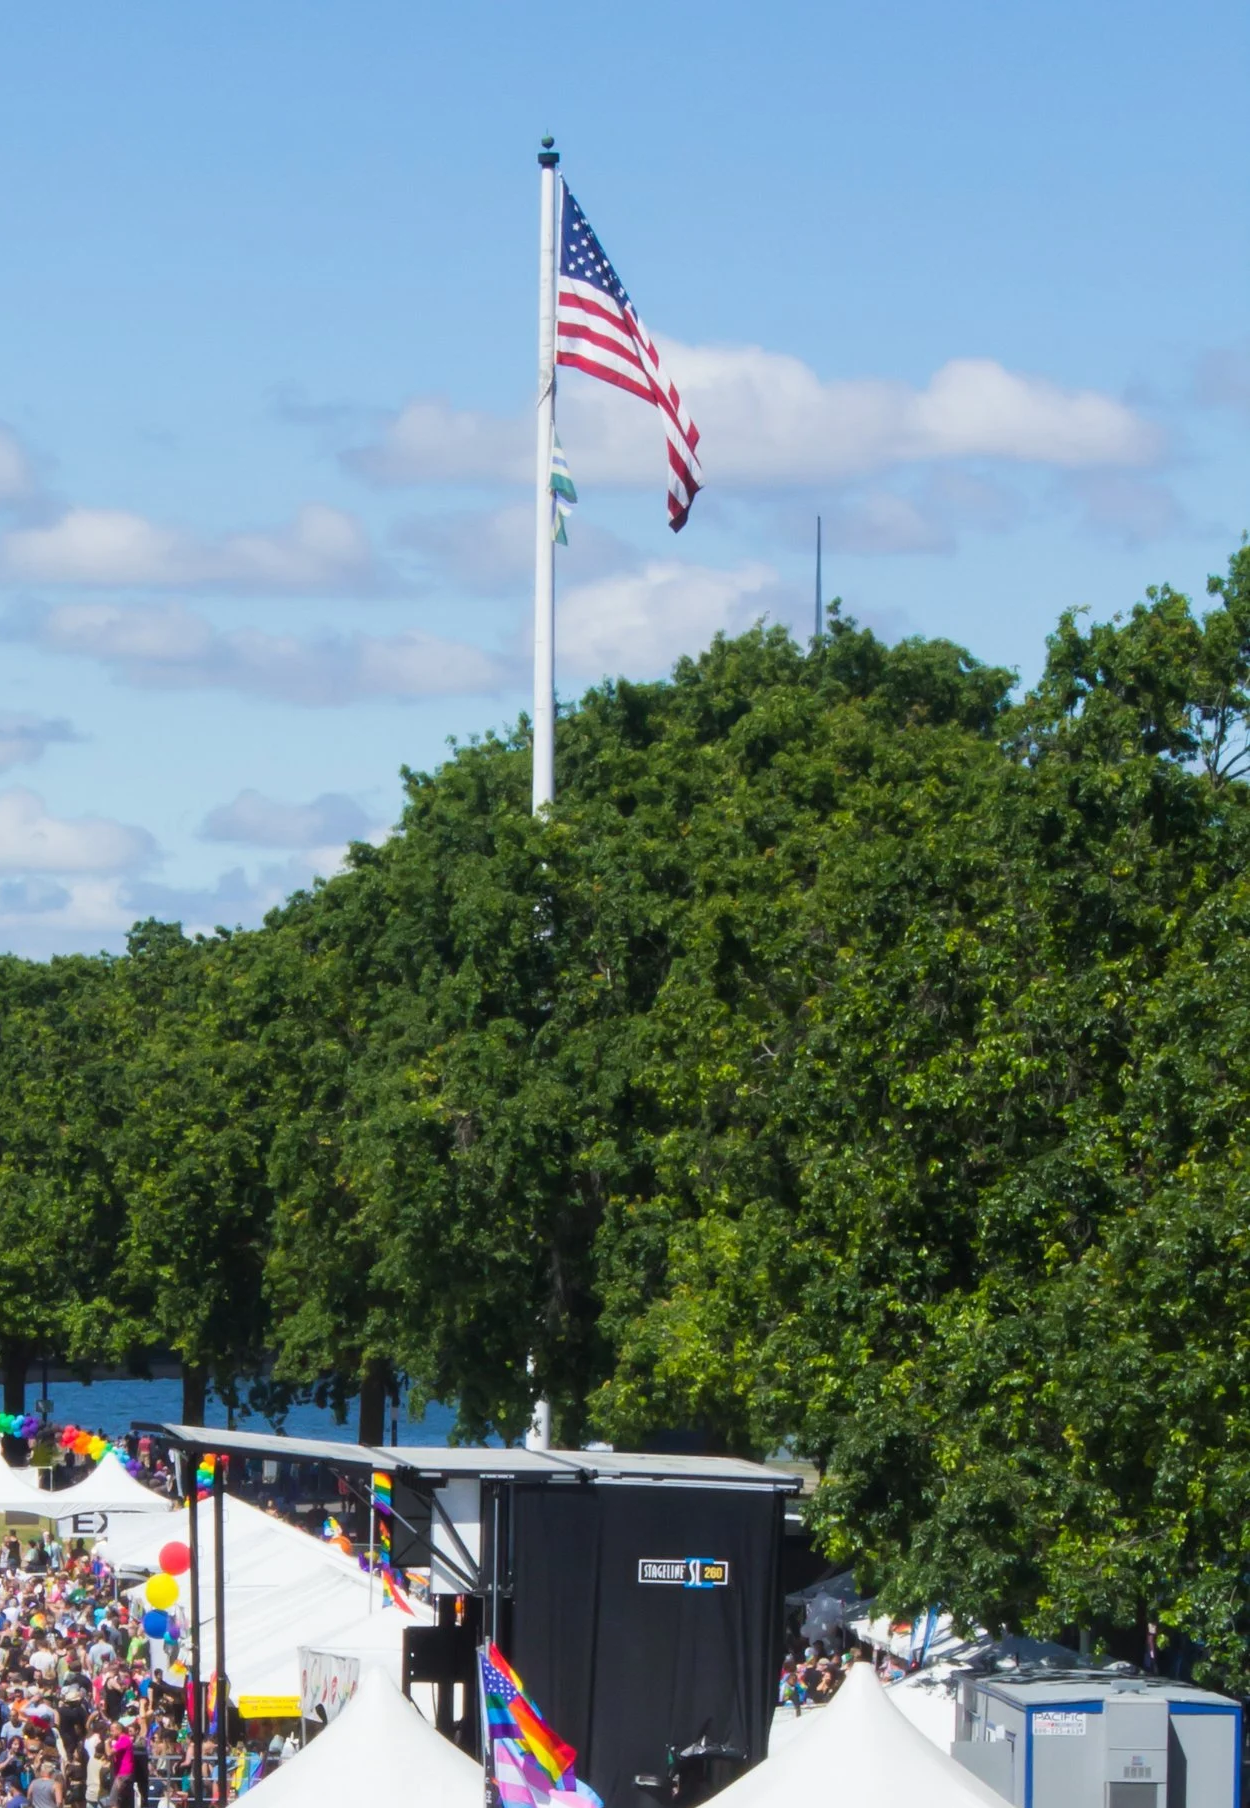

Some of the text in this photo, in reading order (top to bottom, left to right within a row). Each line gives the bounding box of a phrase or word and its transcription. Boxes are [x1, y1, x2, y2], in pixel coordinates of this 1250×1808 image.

[643, 1563, 686, 1579] STAGELINE
[703, 1566, 723, 1579] 260
[1034, 1711, 1083, 1722] PACIFIC
